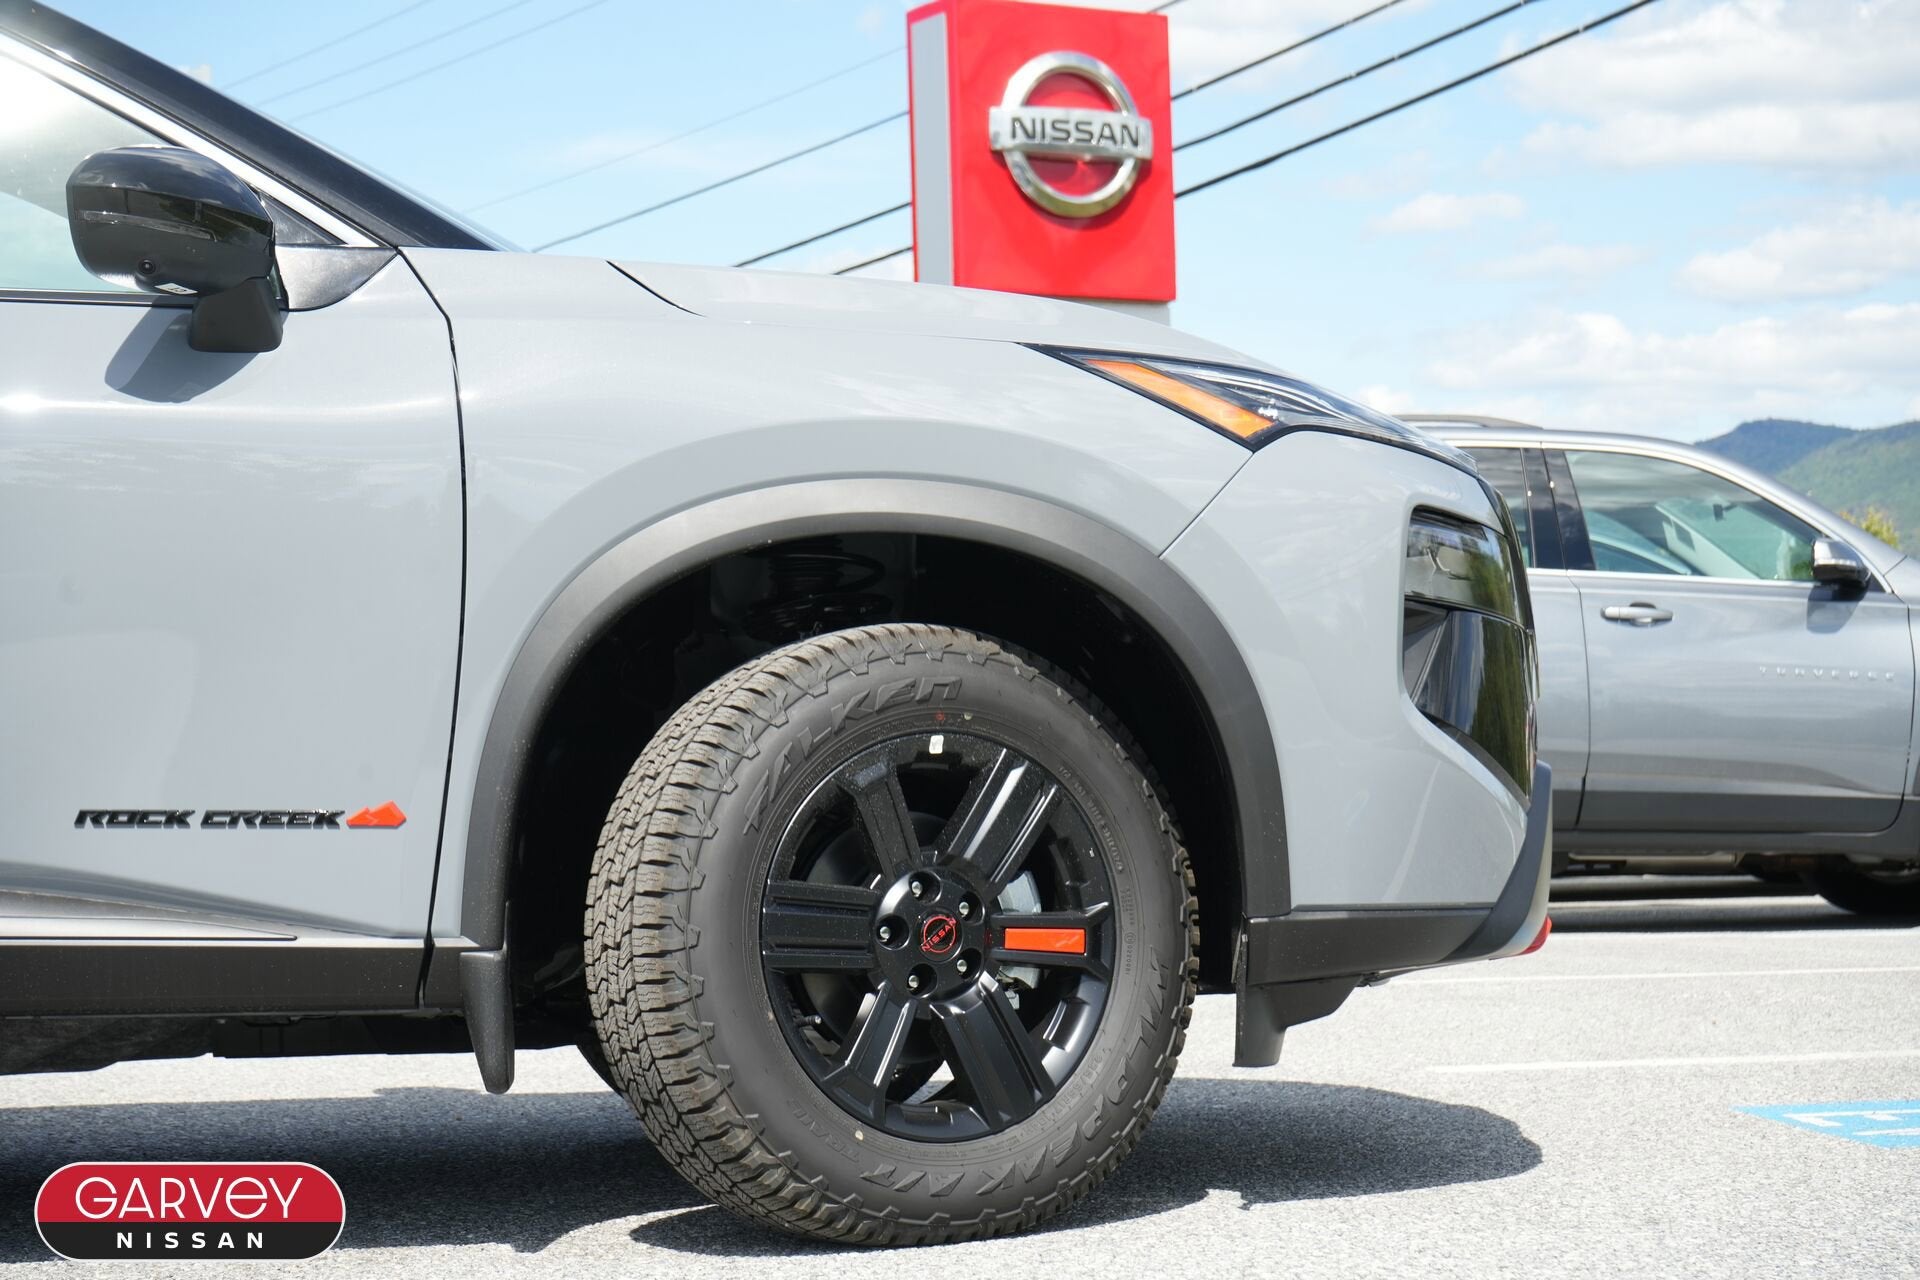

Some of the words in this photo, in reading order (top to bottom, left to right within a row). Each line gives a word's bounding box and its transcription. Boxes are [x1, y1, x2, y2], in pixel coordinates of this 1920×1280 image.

[1011, 117, 1139, 147] NISSAN
[74, 809, 196, 829] ROCK
[200, 808, 345, 829] CREEK
[921, 917, 957, 952] NISSAN
